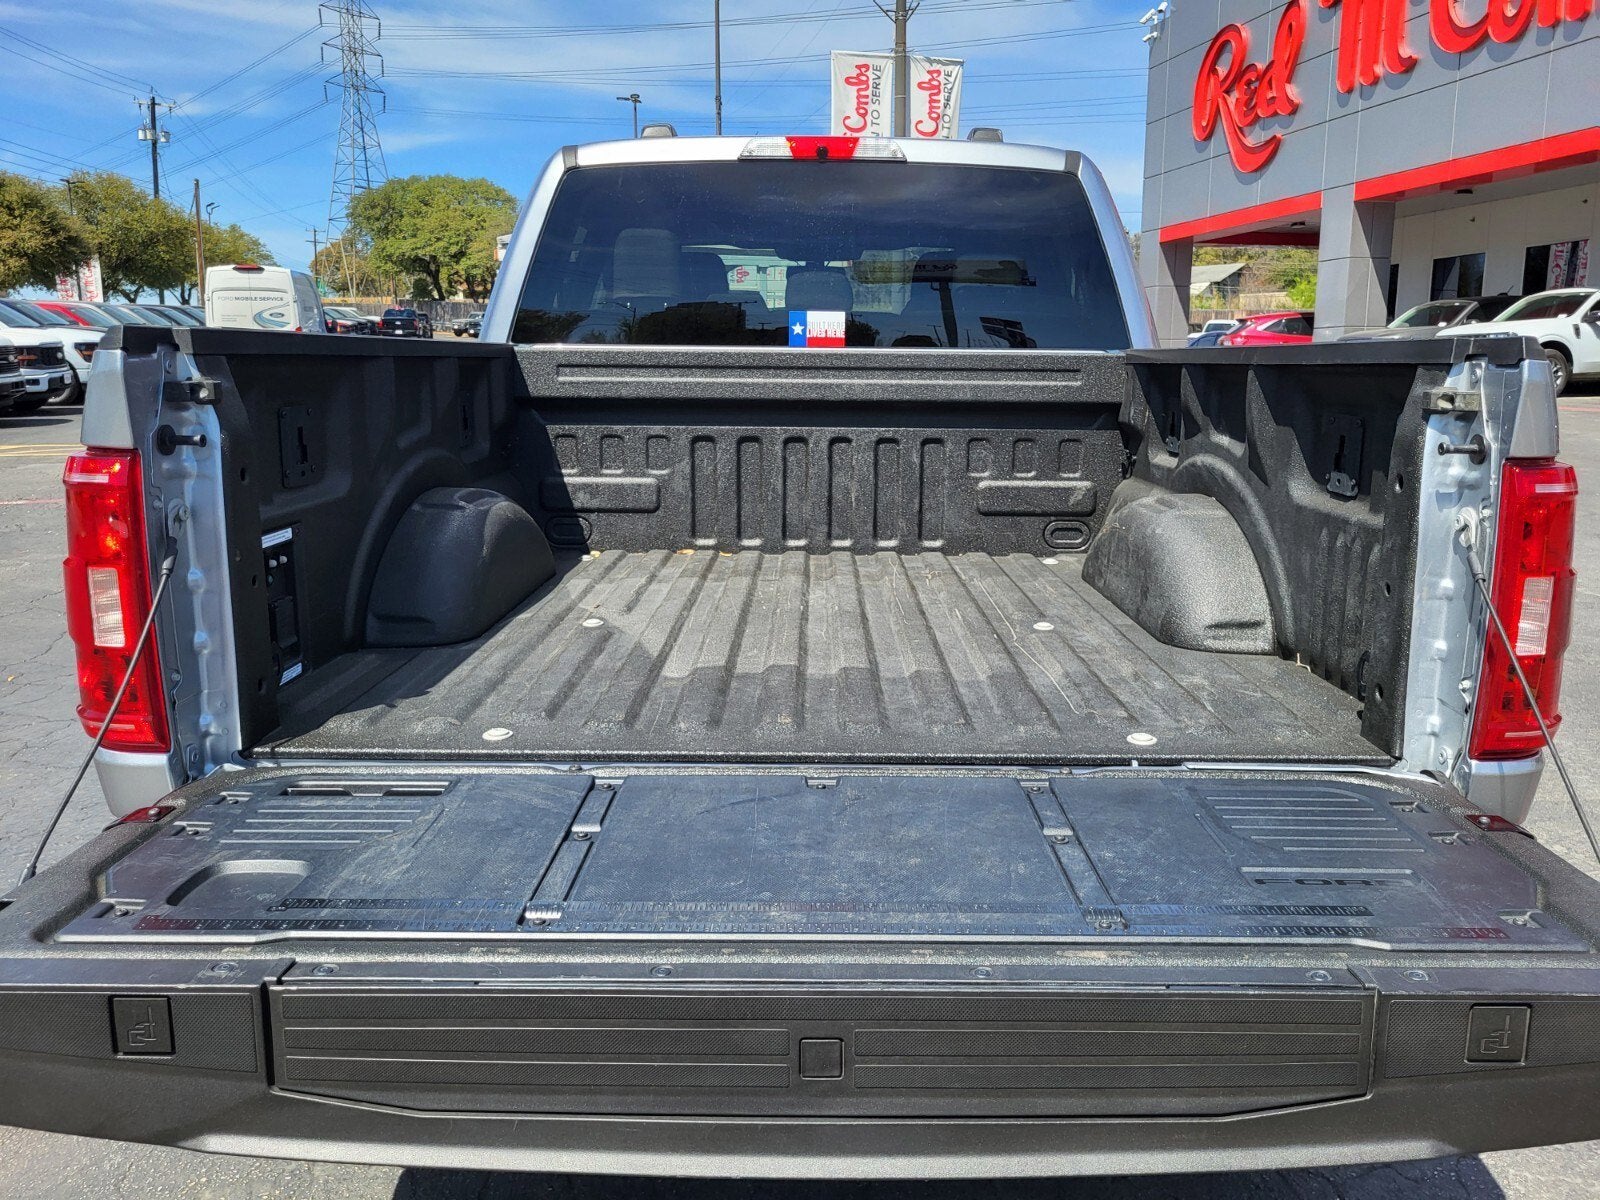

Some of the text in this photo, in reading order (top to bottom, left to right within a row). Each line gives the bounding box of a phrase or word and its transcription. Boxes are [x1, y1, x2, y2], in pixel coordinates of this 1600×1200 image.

[843, 63, 870, 135] Combs
[872, 63, 882, 106] SERVE
[915, 69, 942, 137] Combs
[942, 69, 953, 110] SERVE
[1192, 0, 1304, 172] Red
[871, 110, 881, 128] TO
[942, 113, 952, 132] TO
[807, 329, 845, 337] LIVES HERE
